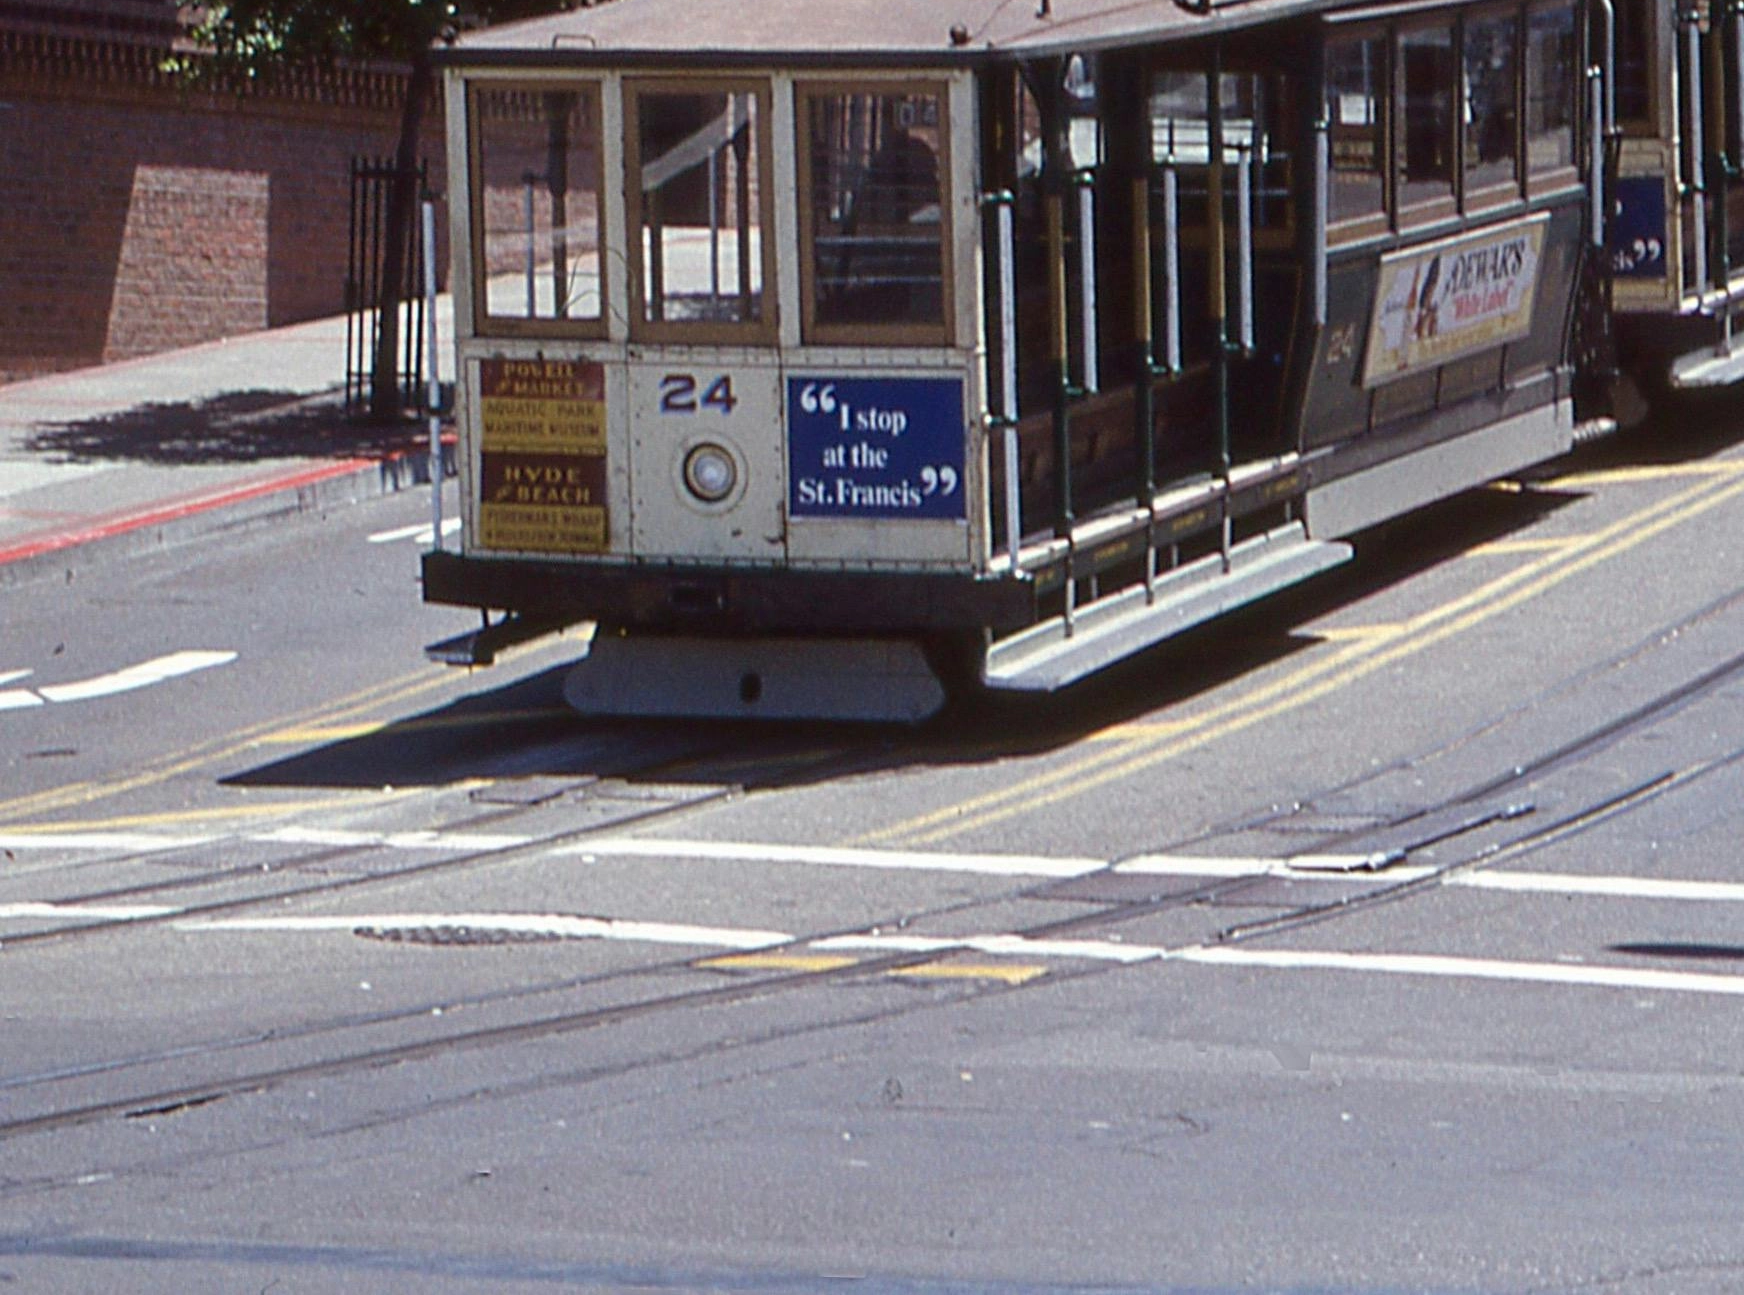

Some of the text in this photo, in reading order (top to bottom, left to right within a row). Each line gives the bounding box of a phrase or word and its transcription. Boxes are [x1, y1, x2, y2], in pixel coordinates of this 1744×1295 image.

[503, 361, 575, 378] POWELL
[513, 381, 584, 396] MARKET
[660, 373, 738, 414] 24
[856, 407, 908, 437] stop
[823, 442, 889, 469] at the
[504, 466, 581, 482] HYDE
[517, 486, 591, 504] BEACH
